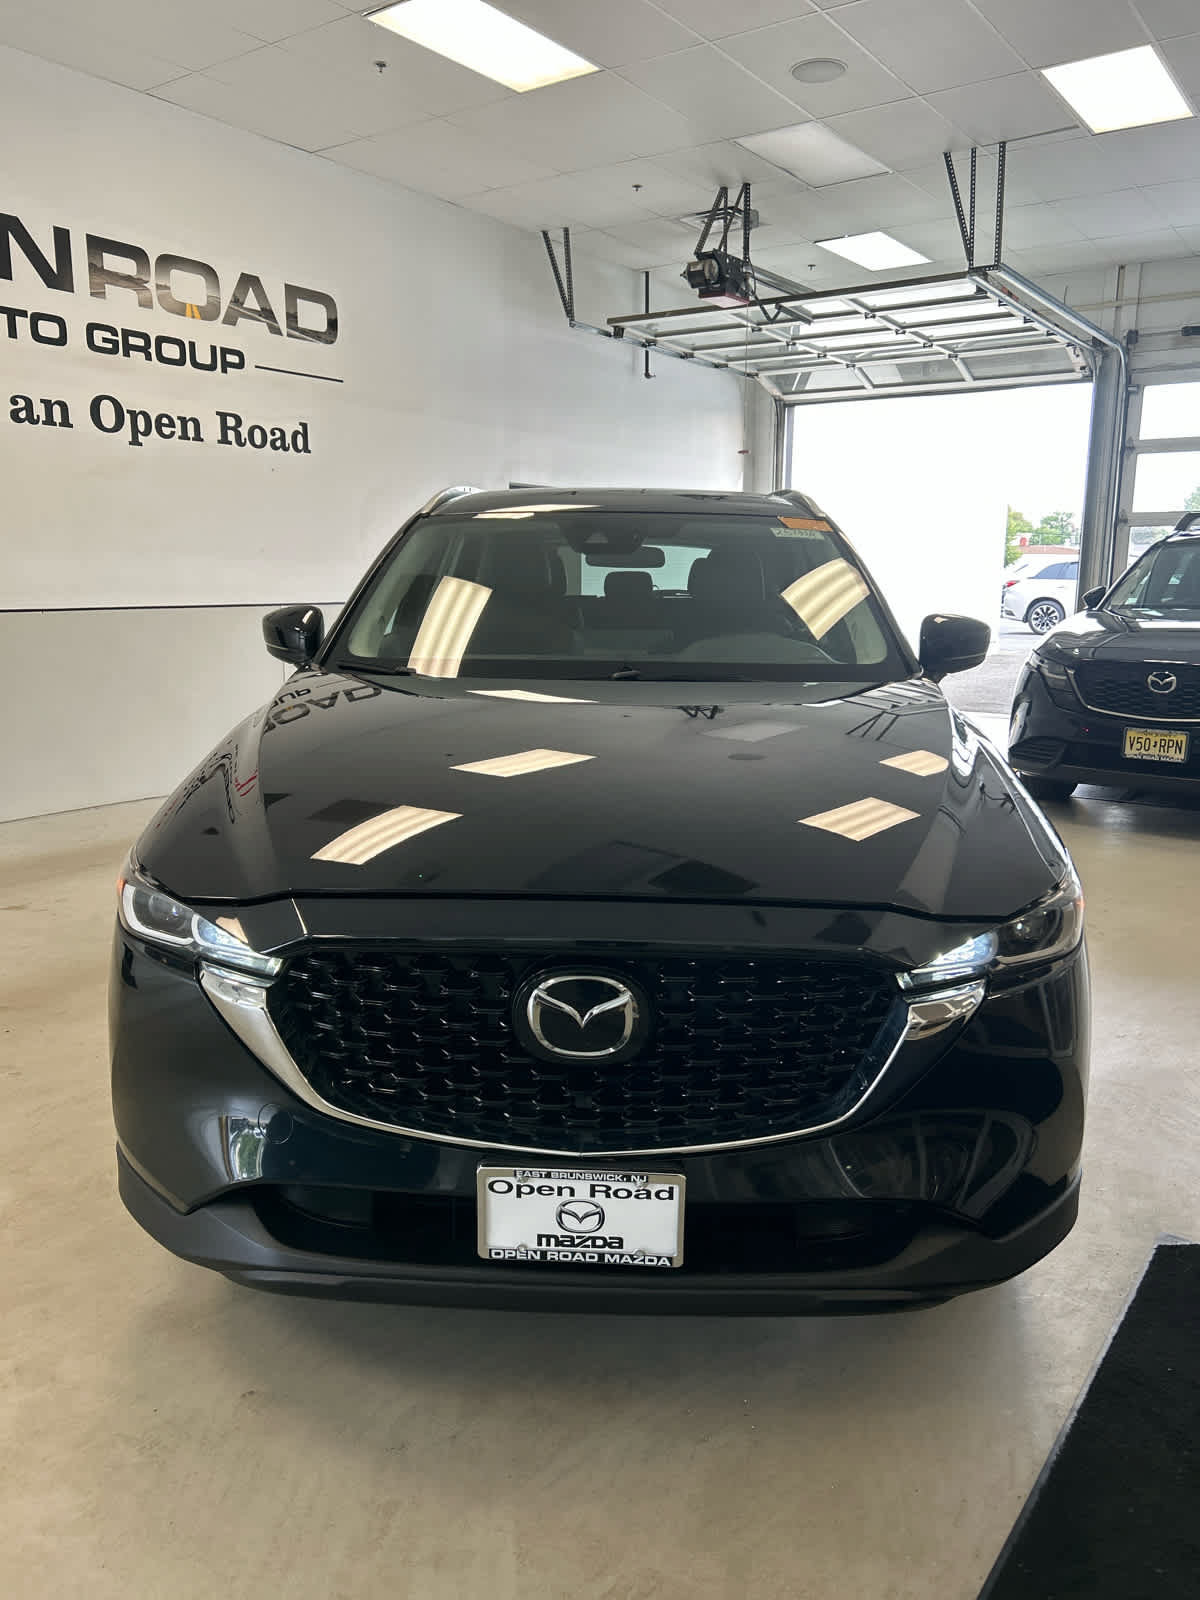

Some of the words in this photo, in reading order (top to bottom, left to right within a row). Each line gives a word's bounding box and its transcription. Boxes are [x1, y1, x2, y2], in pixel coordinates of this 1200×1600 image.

[86, 322, 245, 374] GROUP
[9, 394, 73, 428] an
[89, 394, 204, 447] Open
[215, 410, 312, 454] Road
[515, 1169, 547, 1179] EAST
[630, 1174, 648, 1183] NJ
[487, 1179, 576, 1199] Open
[589, 1183, 675, 1201] Road
[536, 1233, 624, 1250] mazda
[490, 1249, 541, 1261] OPEN
[546, 1251, 599, 1263] ROAD
[604, 1253, 671, 1267] MAZDA
